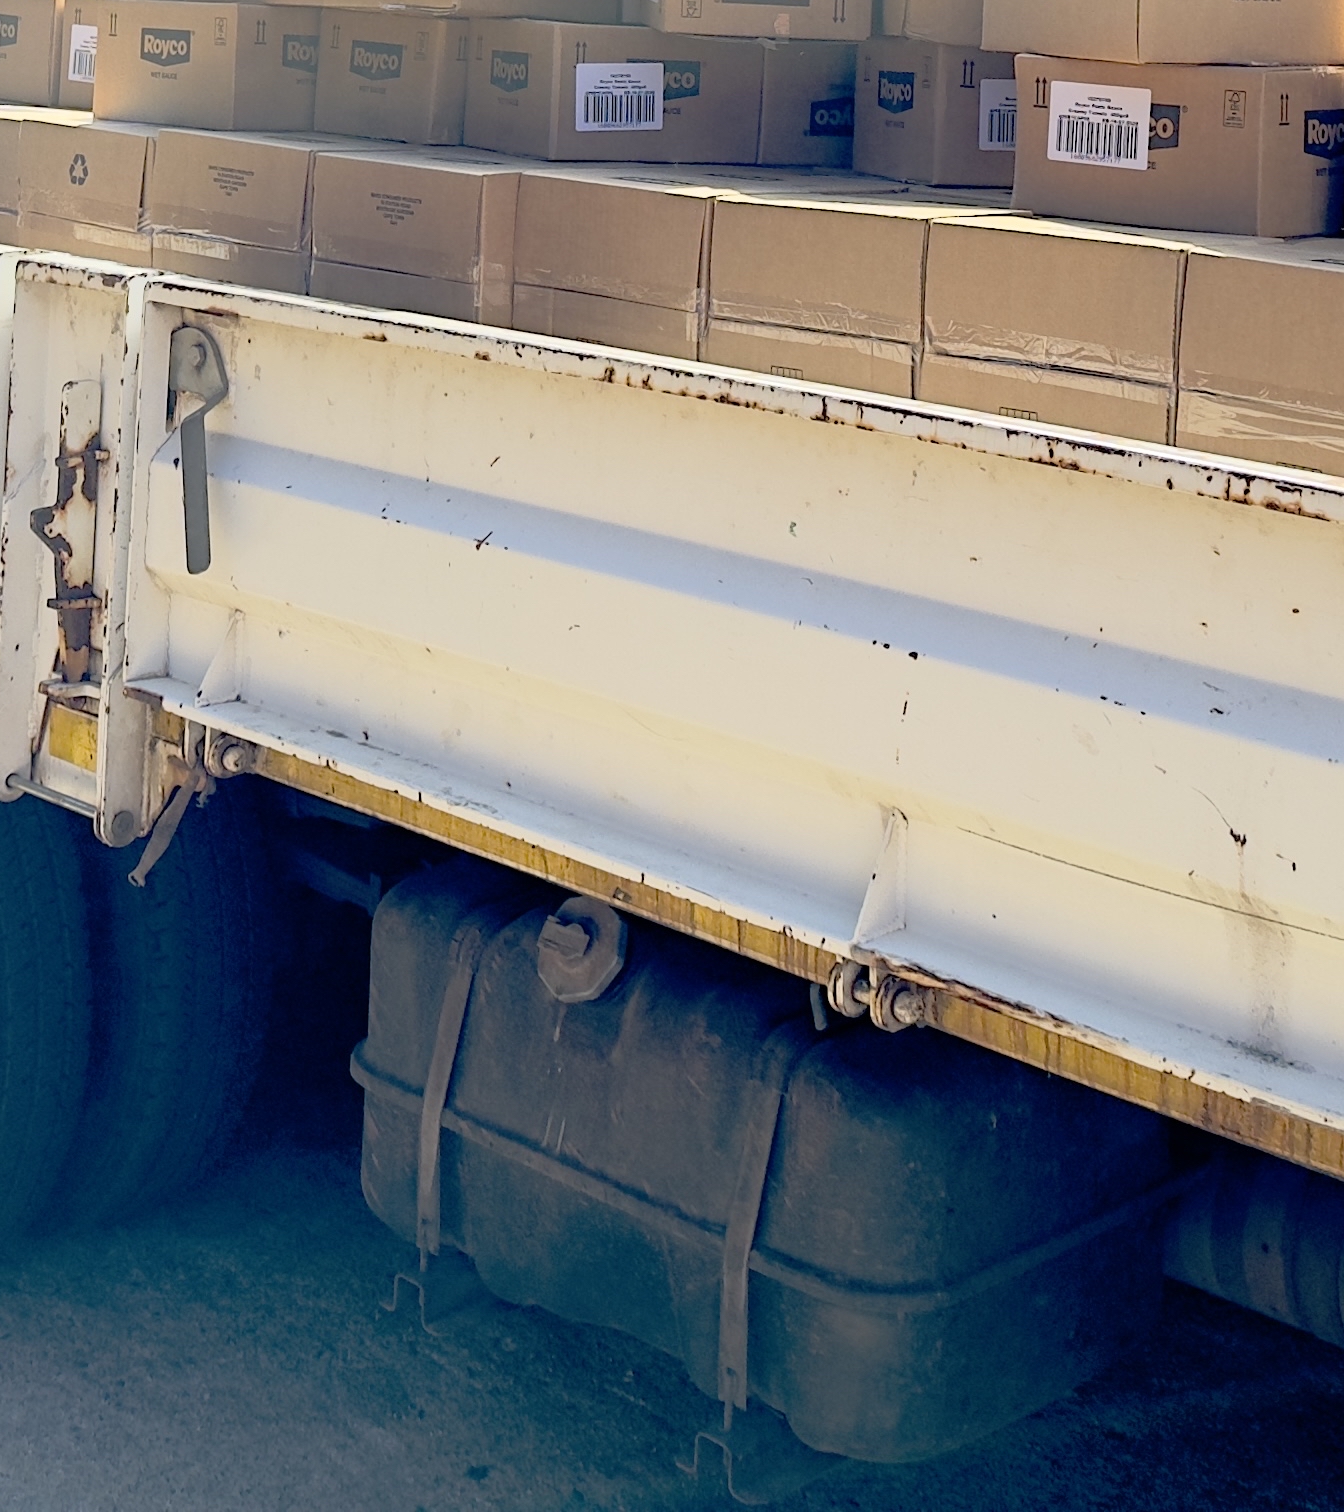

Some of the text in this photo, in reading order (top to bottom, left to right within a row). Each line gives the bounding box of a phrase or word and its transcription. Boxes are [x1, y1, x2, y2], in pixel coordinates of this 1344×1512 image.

[144, 37, 187, 59] Royco
[354, 48, 399, 73] Royco
[494, 57, 526, 84] Royco
[880, 78, 912, 106] Royco
